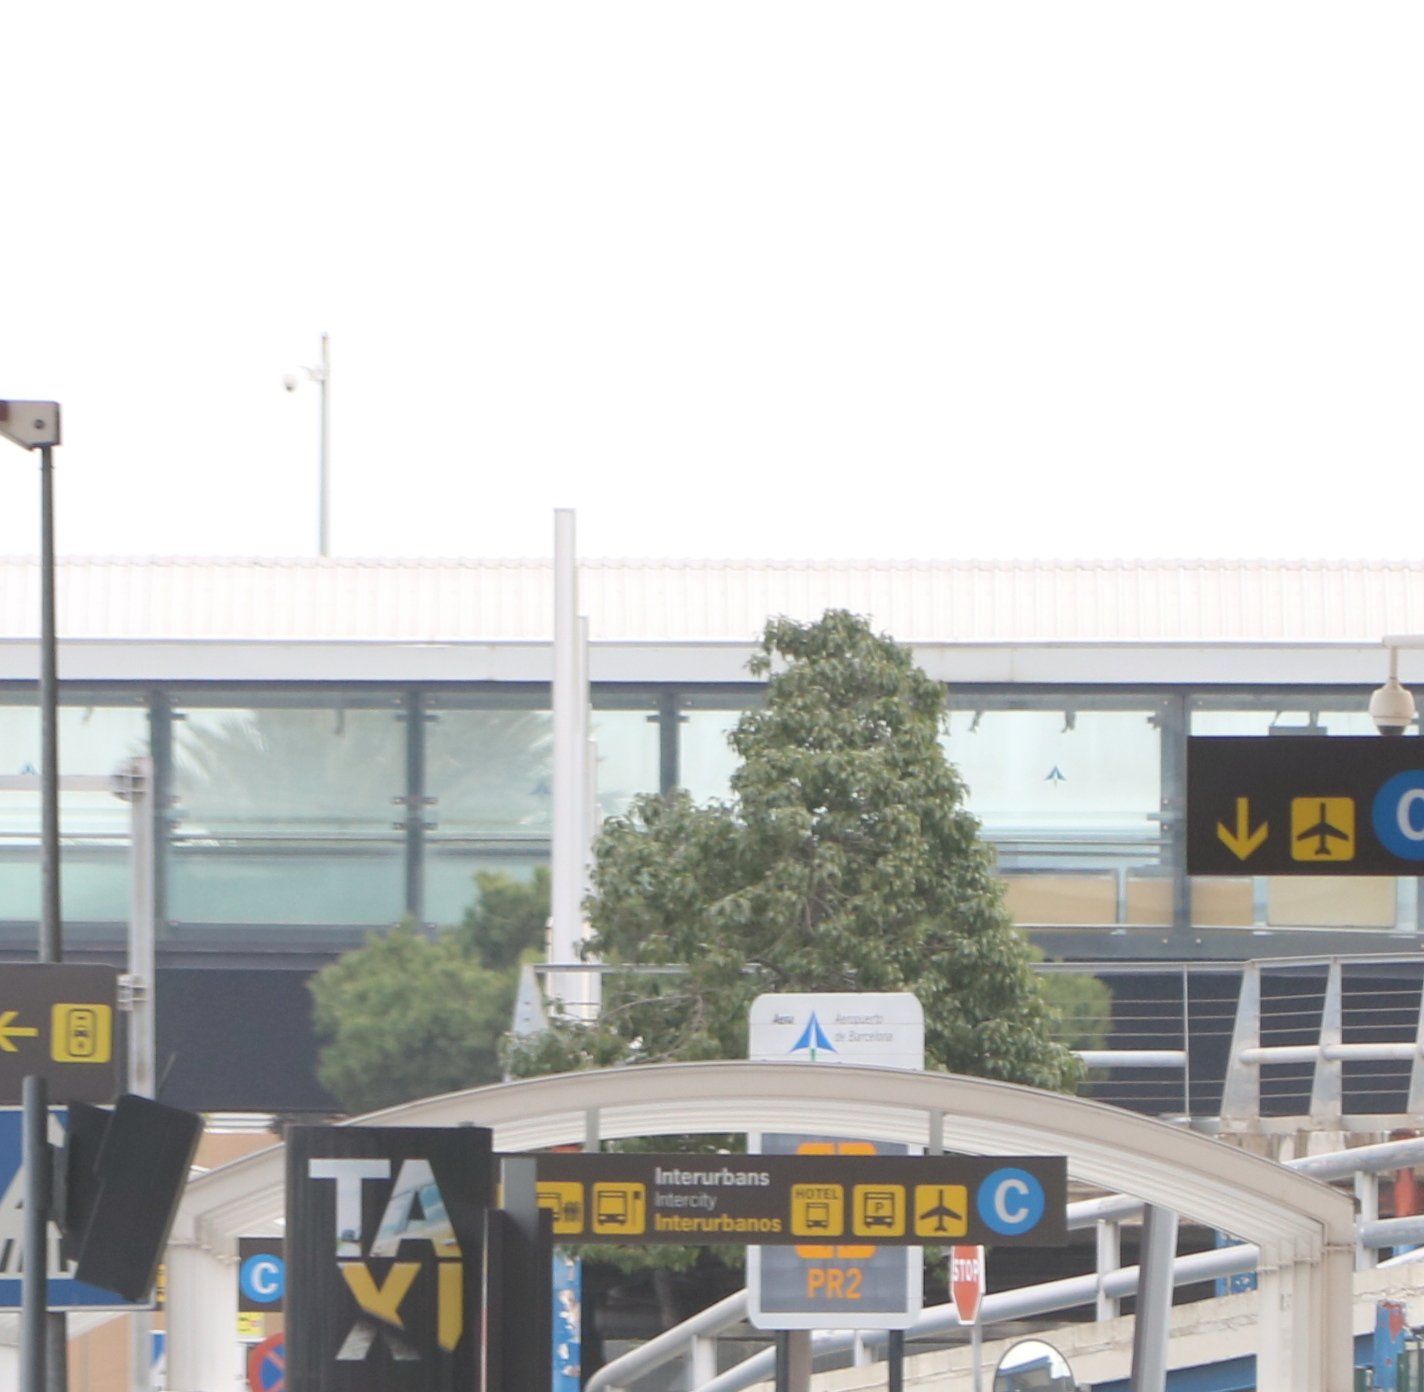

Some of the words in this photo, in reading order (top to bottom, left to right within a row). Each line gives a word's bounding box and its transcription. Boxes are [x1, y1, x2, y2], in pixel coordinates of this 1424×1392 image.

[654, 1166, 770, 1187] Interurbans
[654, 1191, 718, 1210] Intercity
[795, 1188, 840, 1201] HOTEL
[993, 1178, 1030, 1224] C
[654, 1213, 782, 1233] Interurbanos
[250, 1261, 280, 1295] C
[953, 1258, 980, 1282] STOP
[806, 1268, 862, 1299] PR2
